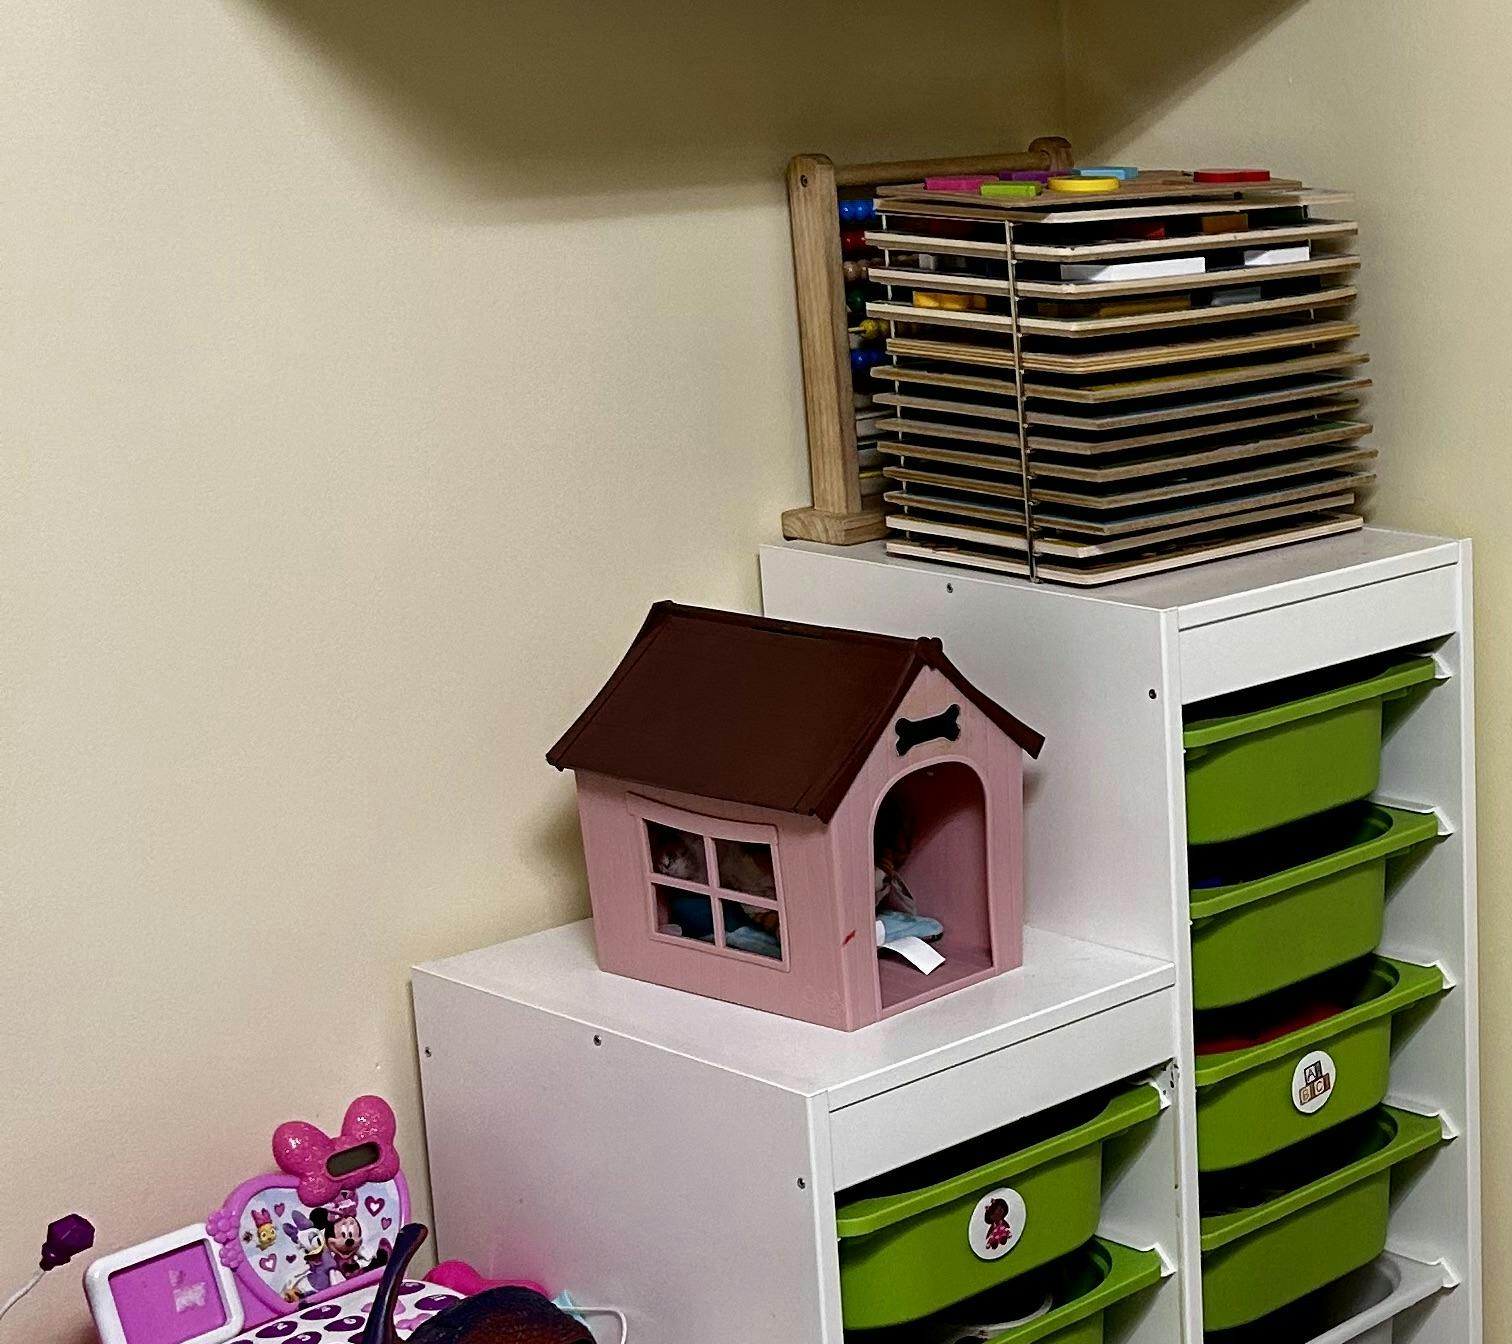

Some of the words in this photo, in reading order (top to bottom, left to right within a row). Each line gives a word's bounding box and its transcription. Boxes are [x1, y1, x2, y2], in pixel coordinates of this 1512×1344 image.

[1308, 1069, 1316, 1081] A
[1303, 1090, 1309, 1101] B
[1317, 1081, 1322, 1092] C
